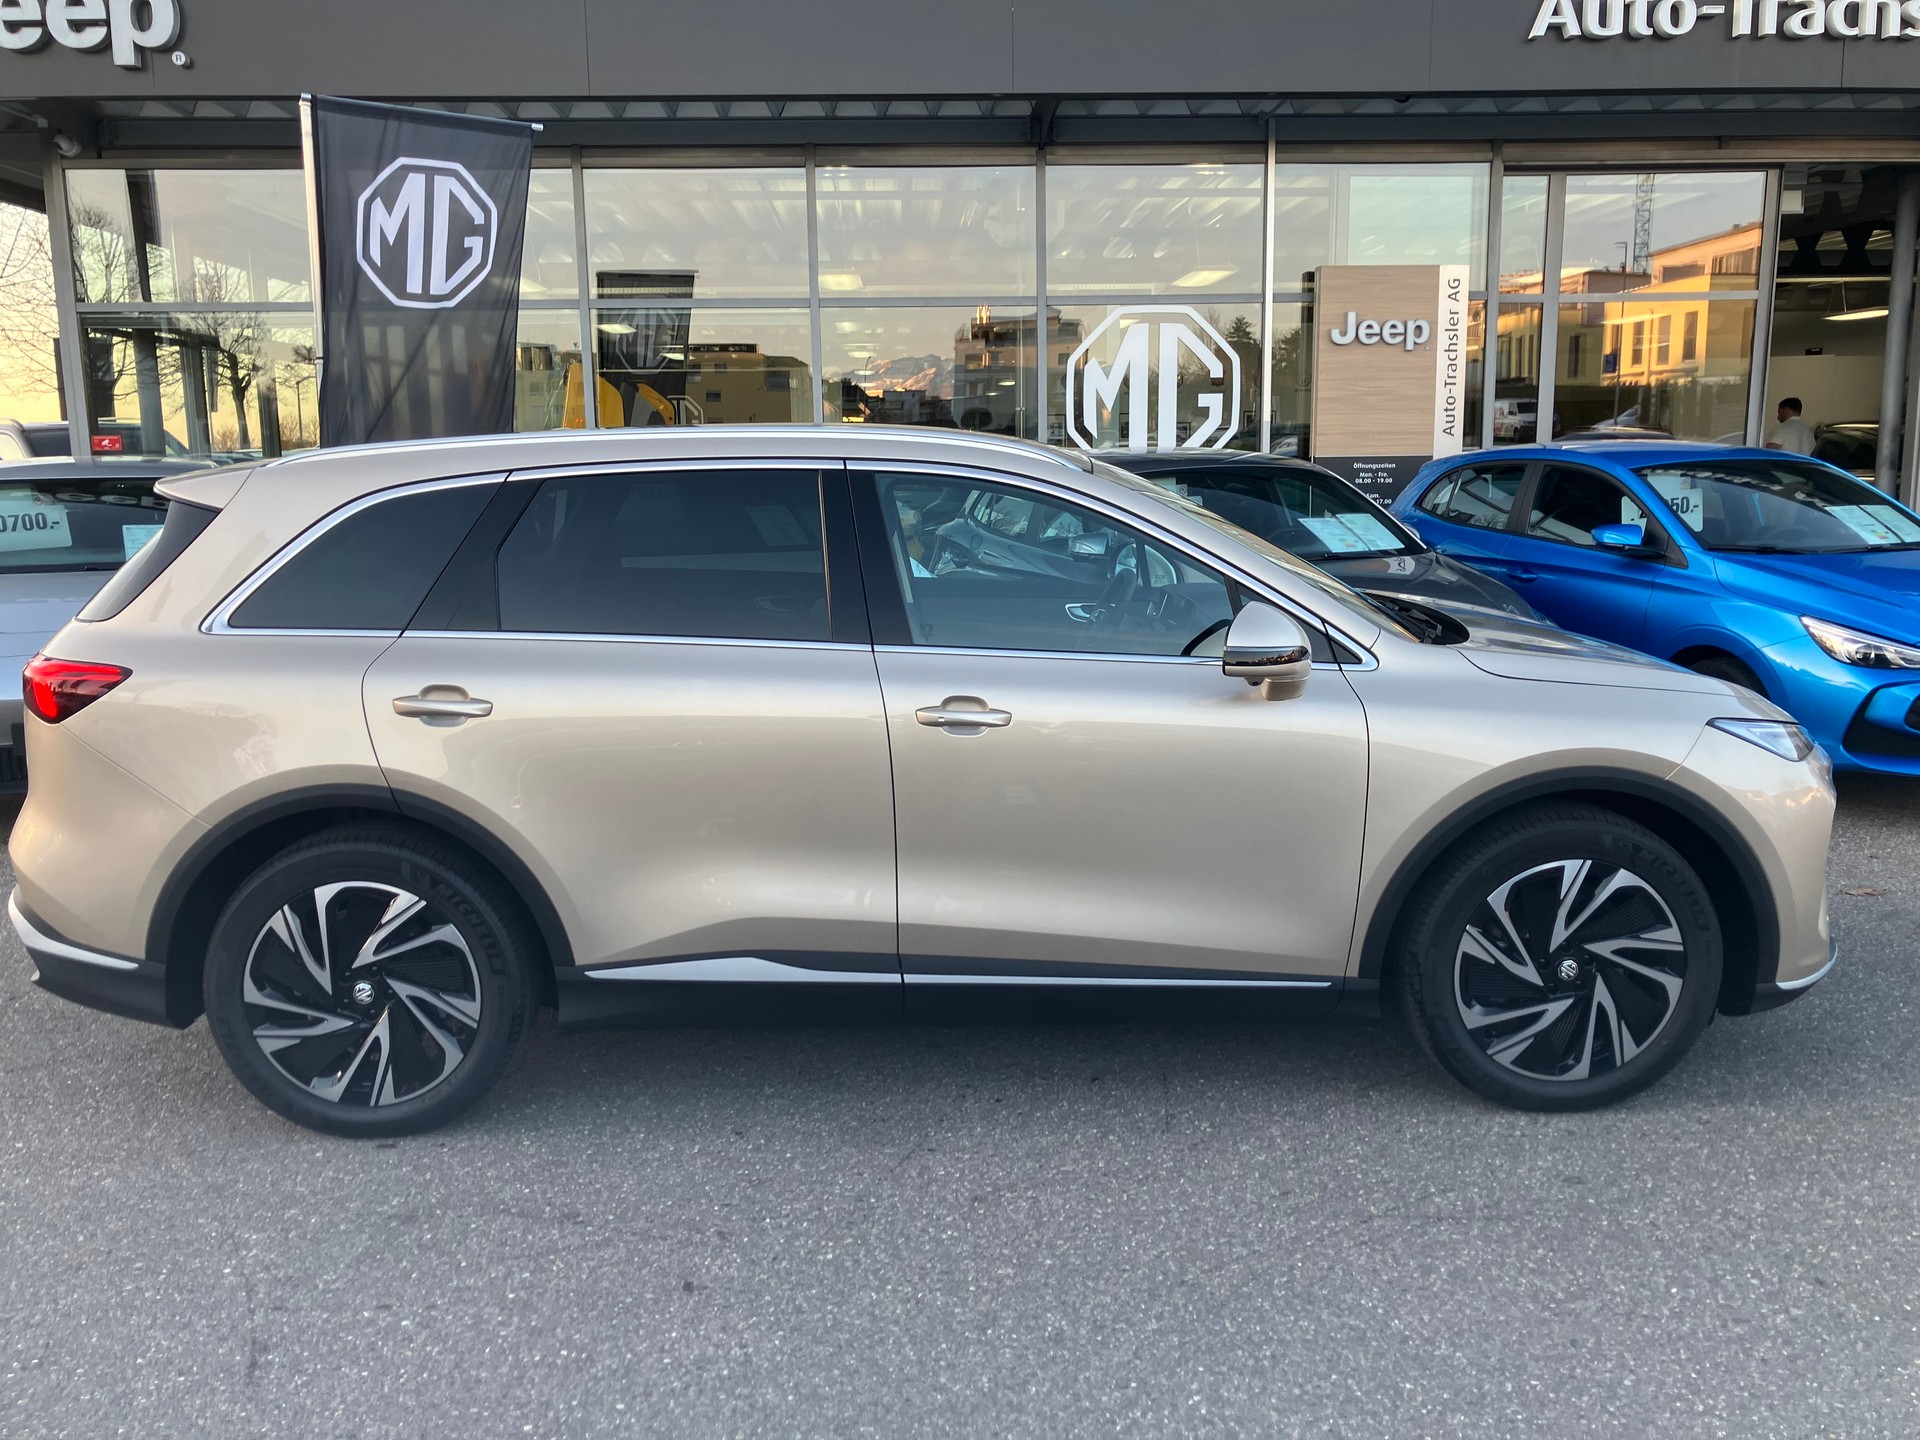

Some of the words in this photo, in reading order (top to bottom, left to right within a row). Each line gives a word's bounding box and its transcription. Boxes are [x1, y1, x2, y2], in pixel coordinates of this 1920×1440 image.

[369, 172, 485, 296] MG
[1330, 311, 1431, 351] Jeep
[1447, 278, 1461, 302] AG
[1083, 322, 1223, 454] MG
[1442, 308, 1460, 437] Auto-Trachsler
[1664, 496, 1700, 514] 50.-
